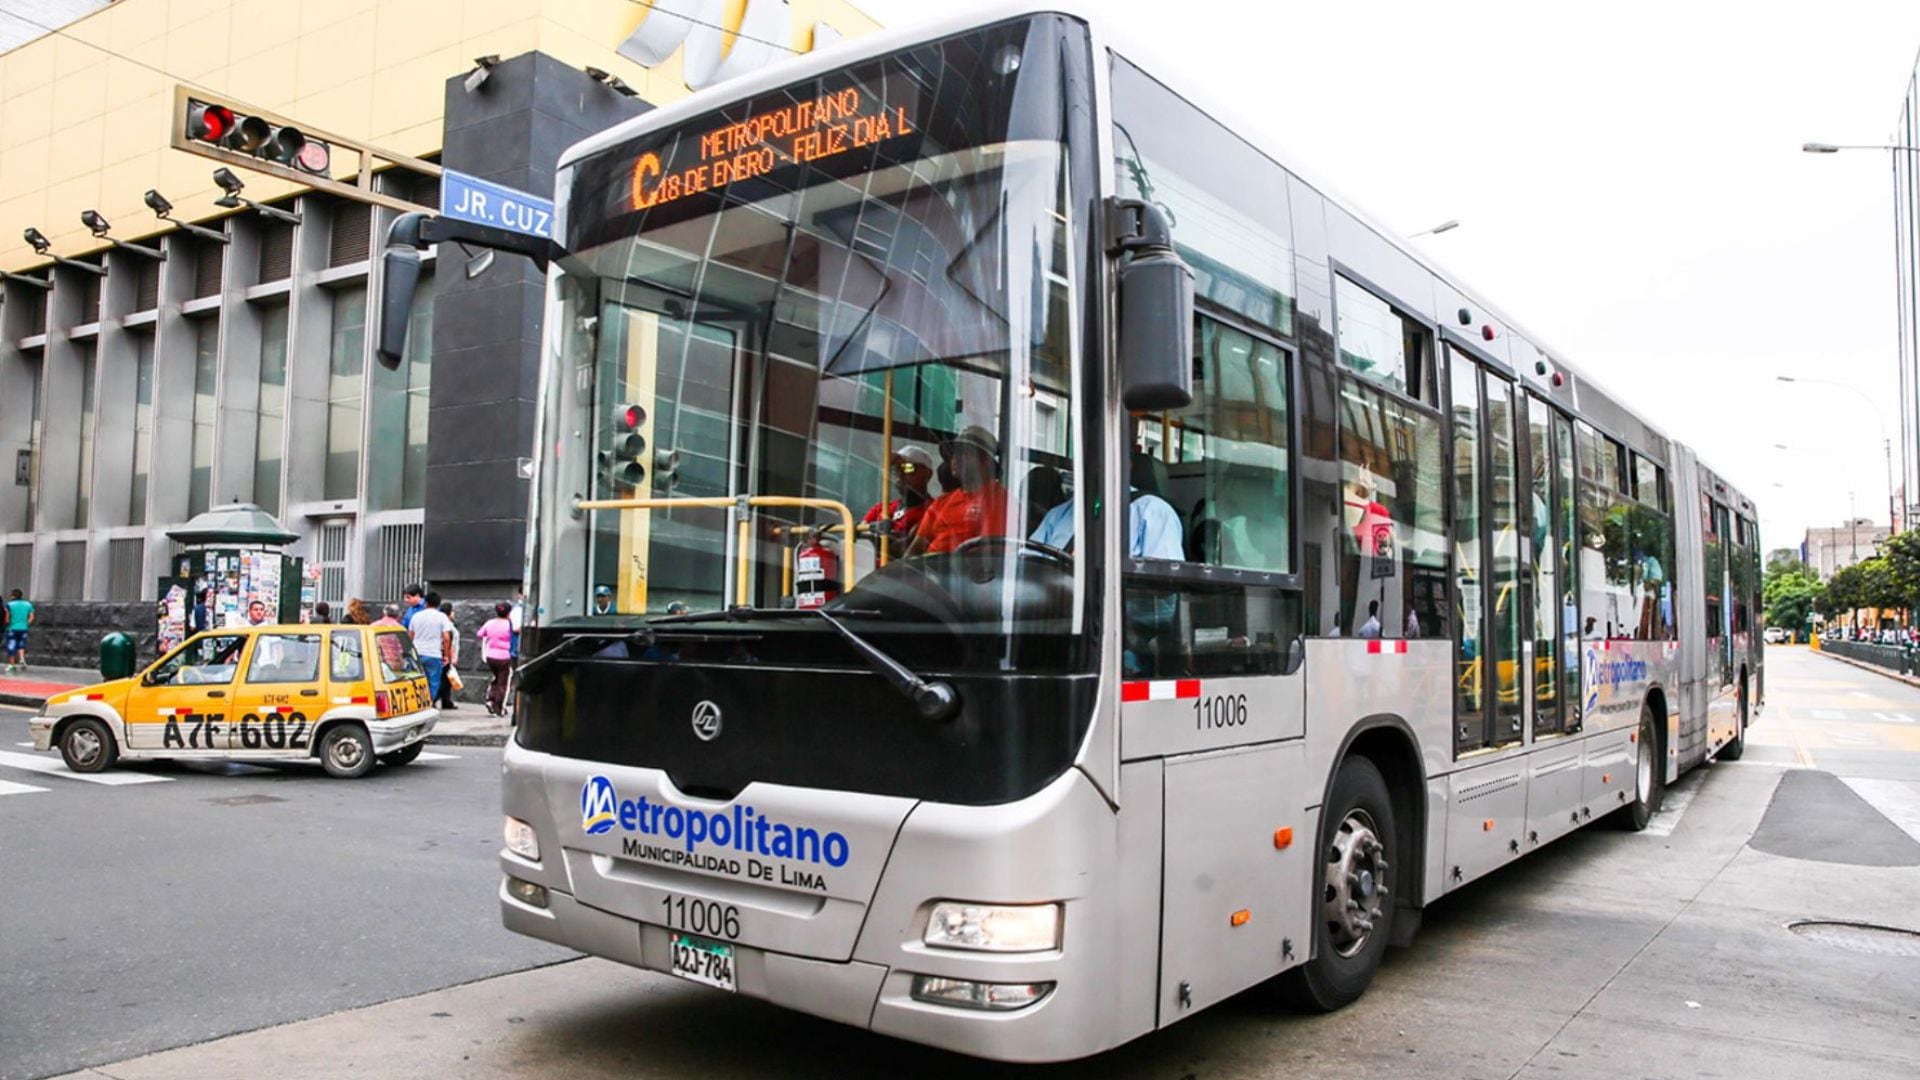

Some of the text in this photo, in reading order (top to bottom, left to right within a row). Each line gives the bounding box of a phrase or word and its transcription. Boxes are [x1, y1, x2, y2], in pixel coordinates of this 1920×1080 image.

[701, 88, 859, 160] METROPOLITANO
[656, 173, 682, 203] 18
[684, 166, 708, 195] DE
[713, 147, 774, 187] ENERO
[793, 124, 848, 164] FELIZ
[853, 112, 891, 147] DIA
[898, 107, 912, 135] L
[632, 152, 662, 211] C
[454, 187, 495, 220] JR.
[163, 711, 307, 750] A7F-602
[1193, 693, 1247, 730] 11006
[662, 894, 740, 939] 11006
[673, 943, 732, 983] A2J-784
